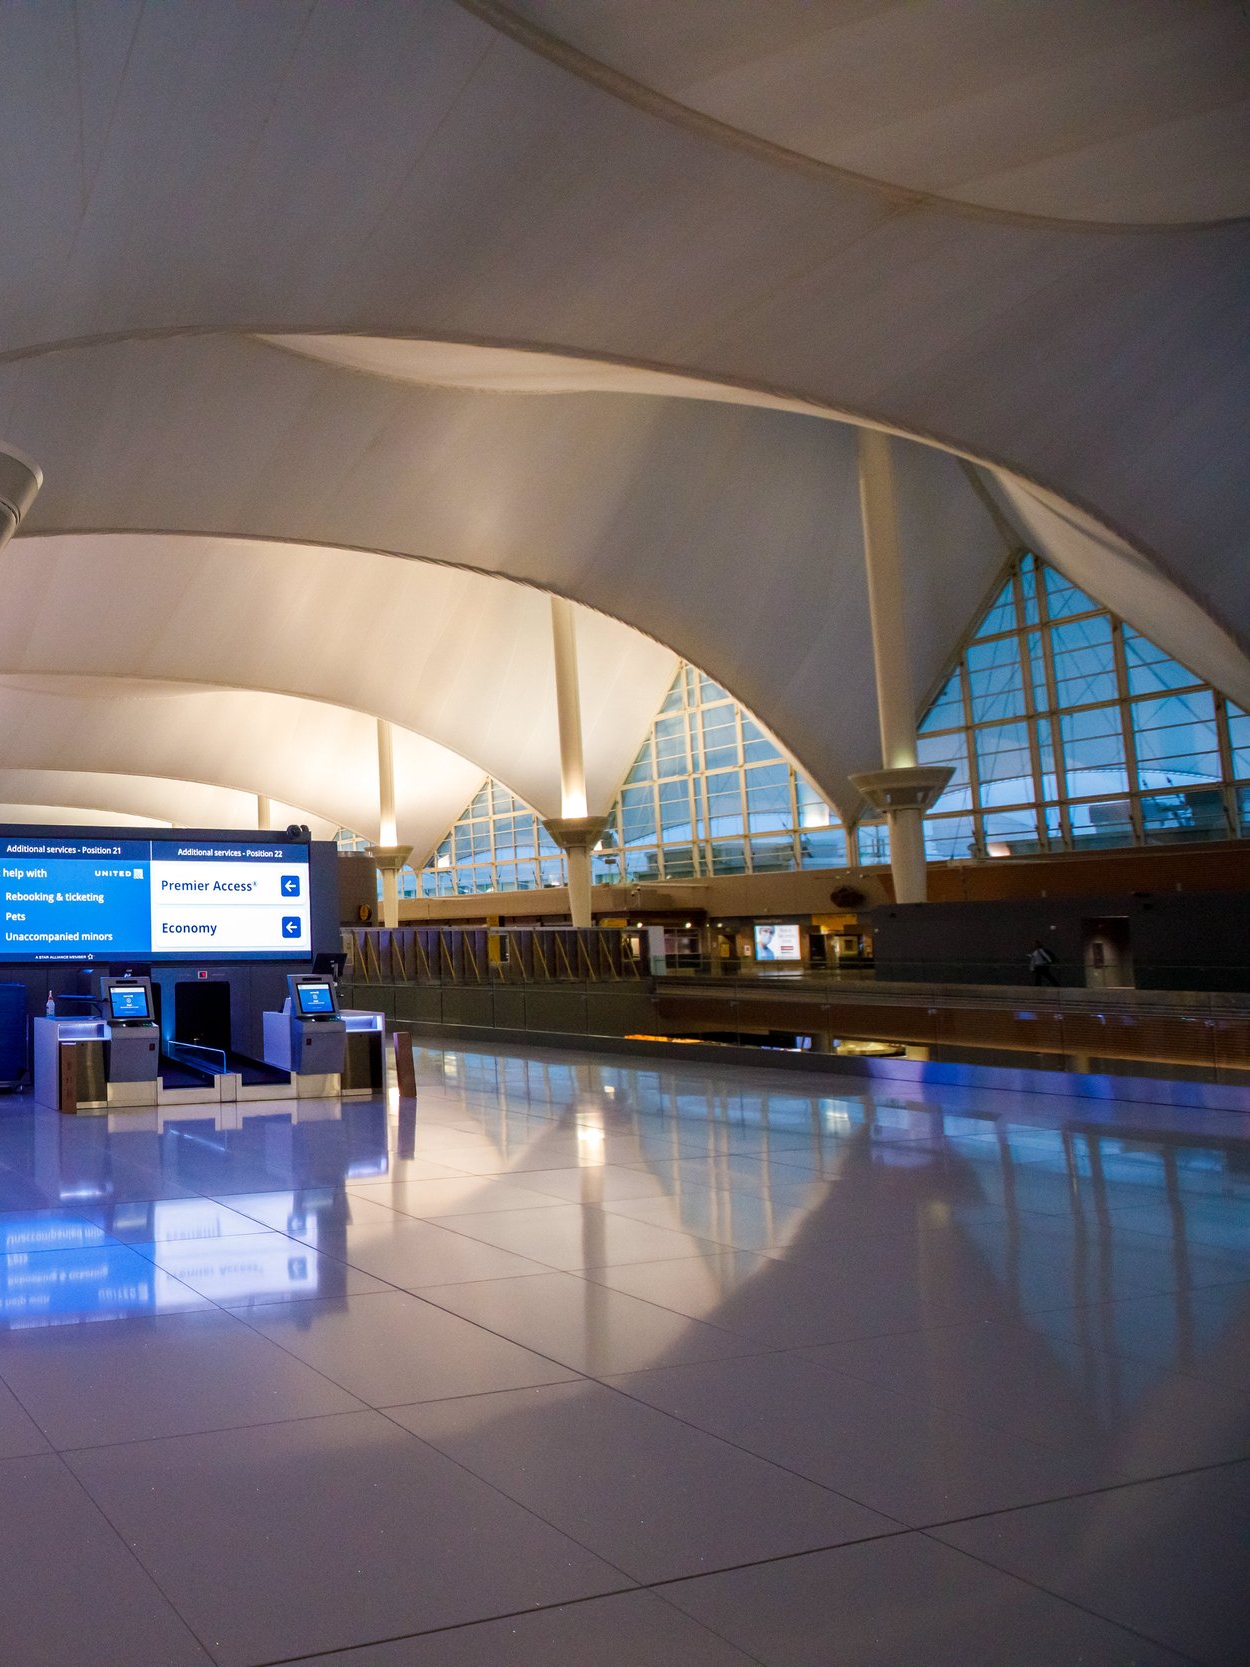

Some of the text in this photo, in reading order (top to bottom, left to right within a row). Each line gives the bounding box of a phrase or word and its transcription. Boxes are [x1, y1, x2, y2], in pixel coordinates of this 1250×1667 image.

[6, 845, 45, 853] Additional
[47, 846, 76, 854] services
[178, 848, 213, 856] Additional
[274, 850, 283, 858] 22
[3, 868, 24, 879] help
[26, 868, 47, 878] with
[161, 880, 209, 891] Premier
[6, 892, 104, 904] Rebooking & ticketing
[6, 912, 26, 921] Pets
[162, 922, 217, 936] Economy
[5, 932, 113, 943] Unaccompanied minors
